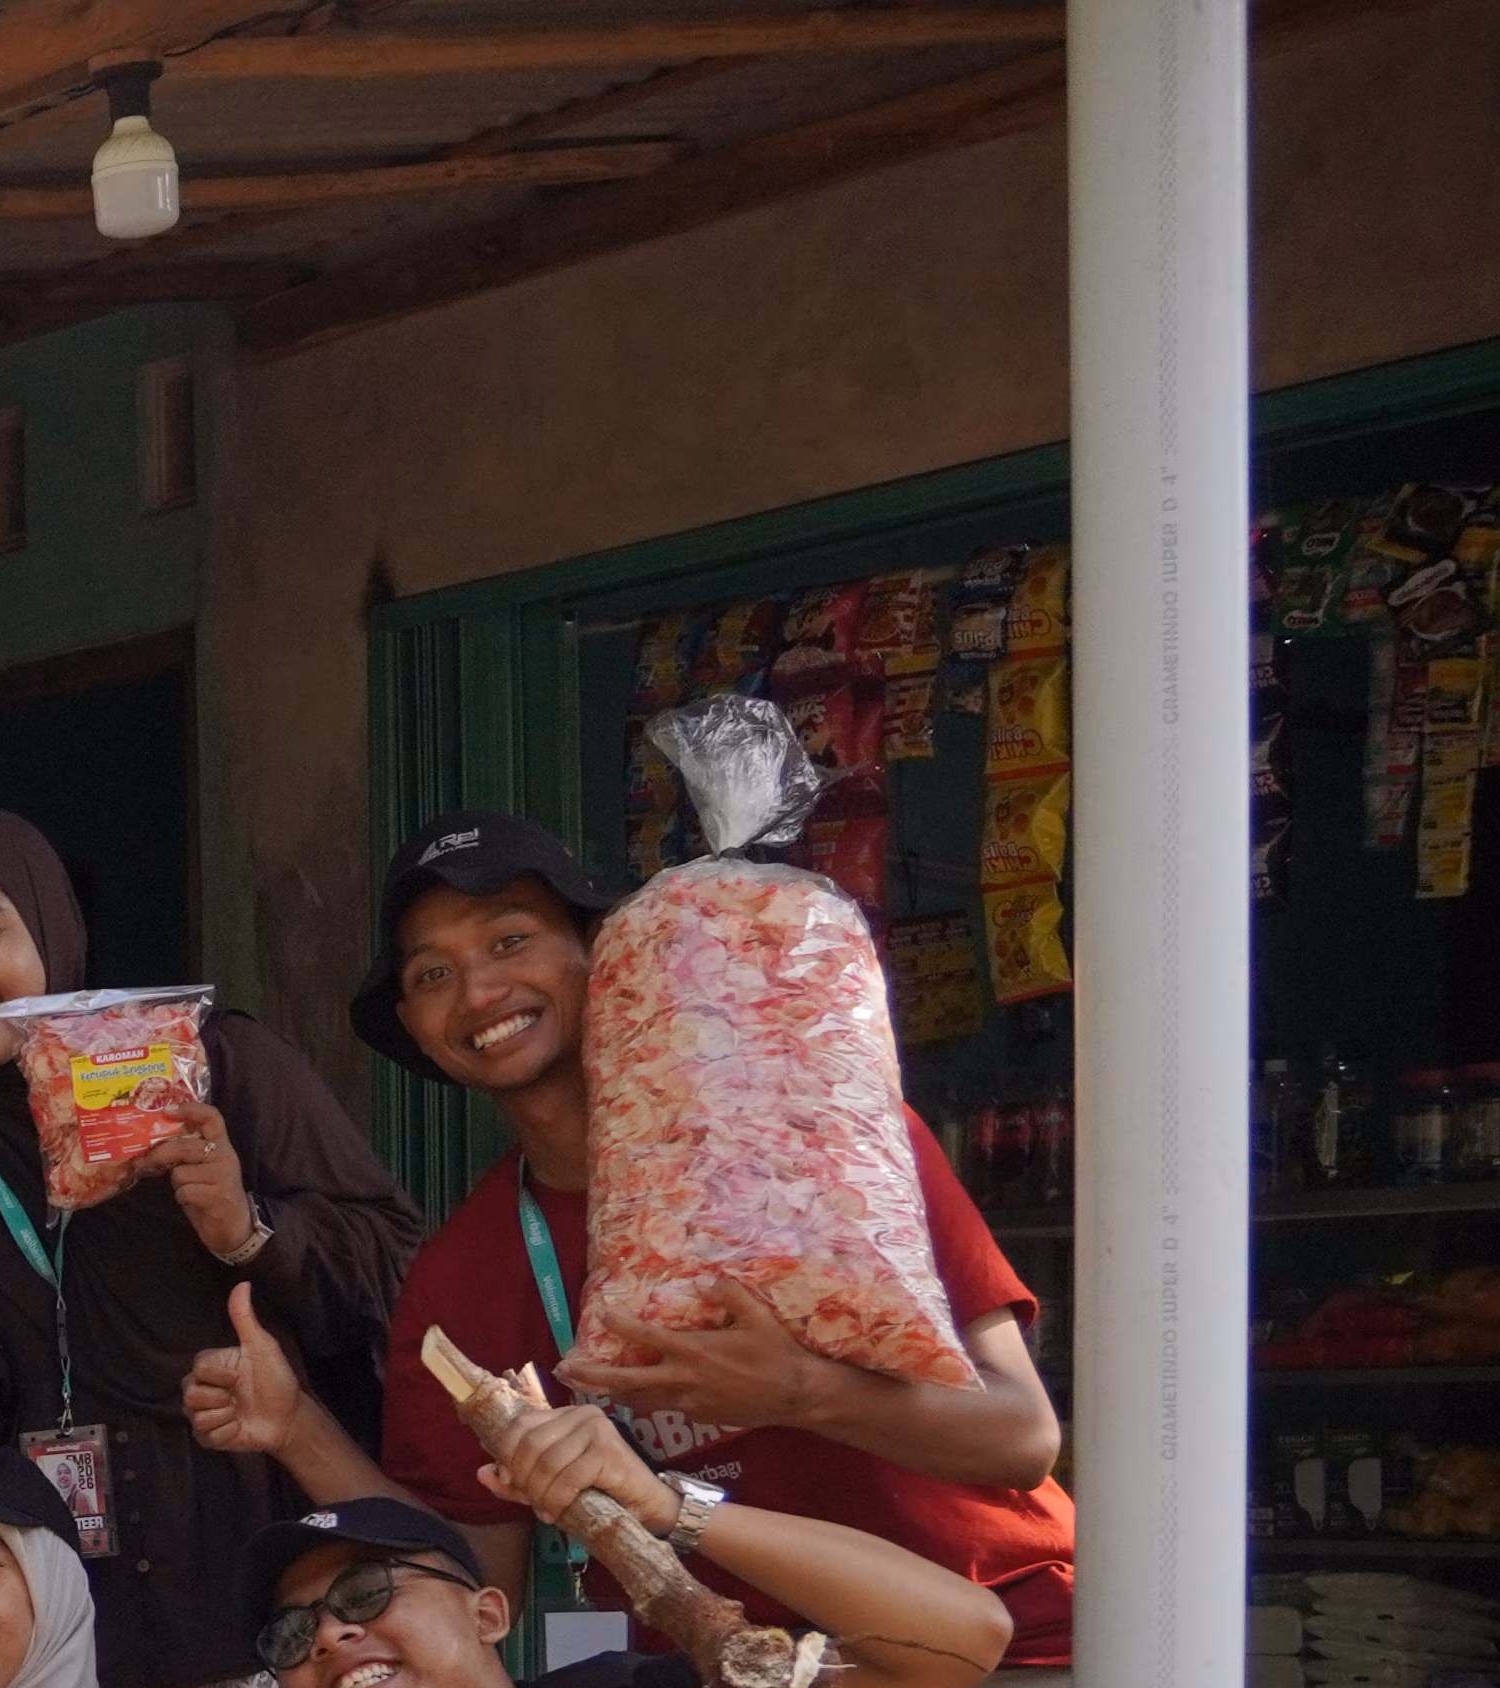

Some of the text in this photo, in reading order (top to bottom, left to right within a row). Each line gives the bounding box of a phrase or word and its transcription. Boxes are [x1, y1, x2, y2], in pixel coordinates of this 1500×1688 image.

[1162, 498, 1178, 511] D
[1161, 524, 1179, 583] SUPER
[96, 1049, 144, 1063] KAROMAH
[1162, 1237, 1178, 1251] D
[542, 1274, 563, 1323] Volunteer
[1161, 1262, 1179, 1322] SUPER
